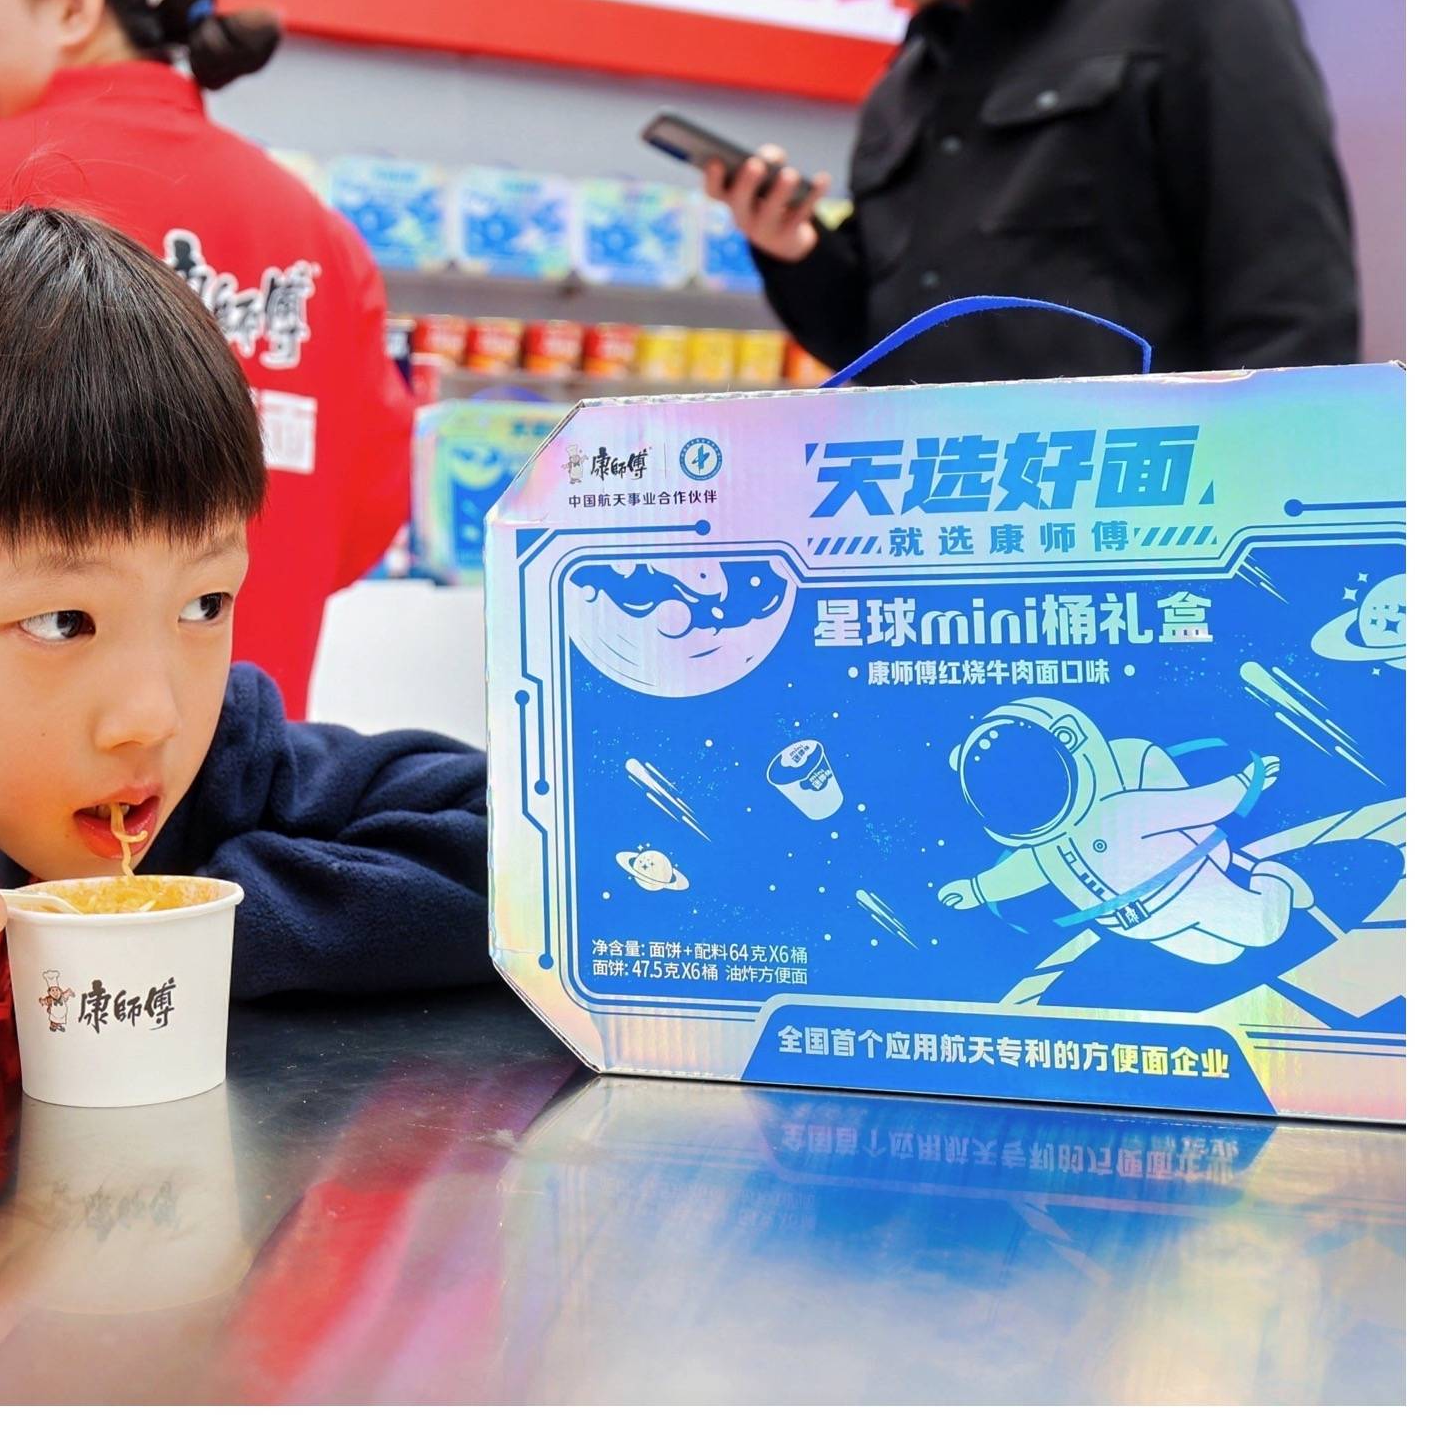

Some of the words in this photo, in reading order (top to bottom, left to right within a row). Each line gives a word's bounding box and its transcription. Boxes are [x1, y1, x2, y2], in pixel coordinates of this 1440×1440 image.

[591, 447, 648, 481] 康師傅
[810, 425, 1199, 519] 天选好面
[569, 490, 717, 508] 中国航天事业合作伙伴
[889, 520, 1129, 557] 就选康师傅
[814, 591, 1213, 648] 星球mini桶礼盒
[868, 660, 1110, 686] 康师傅红烧牛肉面口味
[593, 959, 718, 981] 面饼:47.5克X6桶
[726, 965, 808, 985] 油炸方便面
[78, 977, 177, 1034] 康師傅
[778, 1024, 1230, 1080] 全国首个应用航天专利的方便面企业
